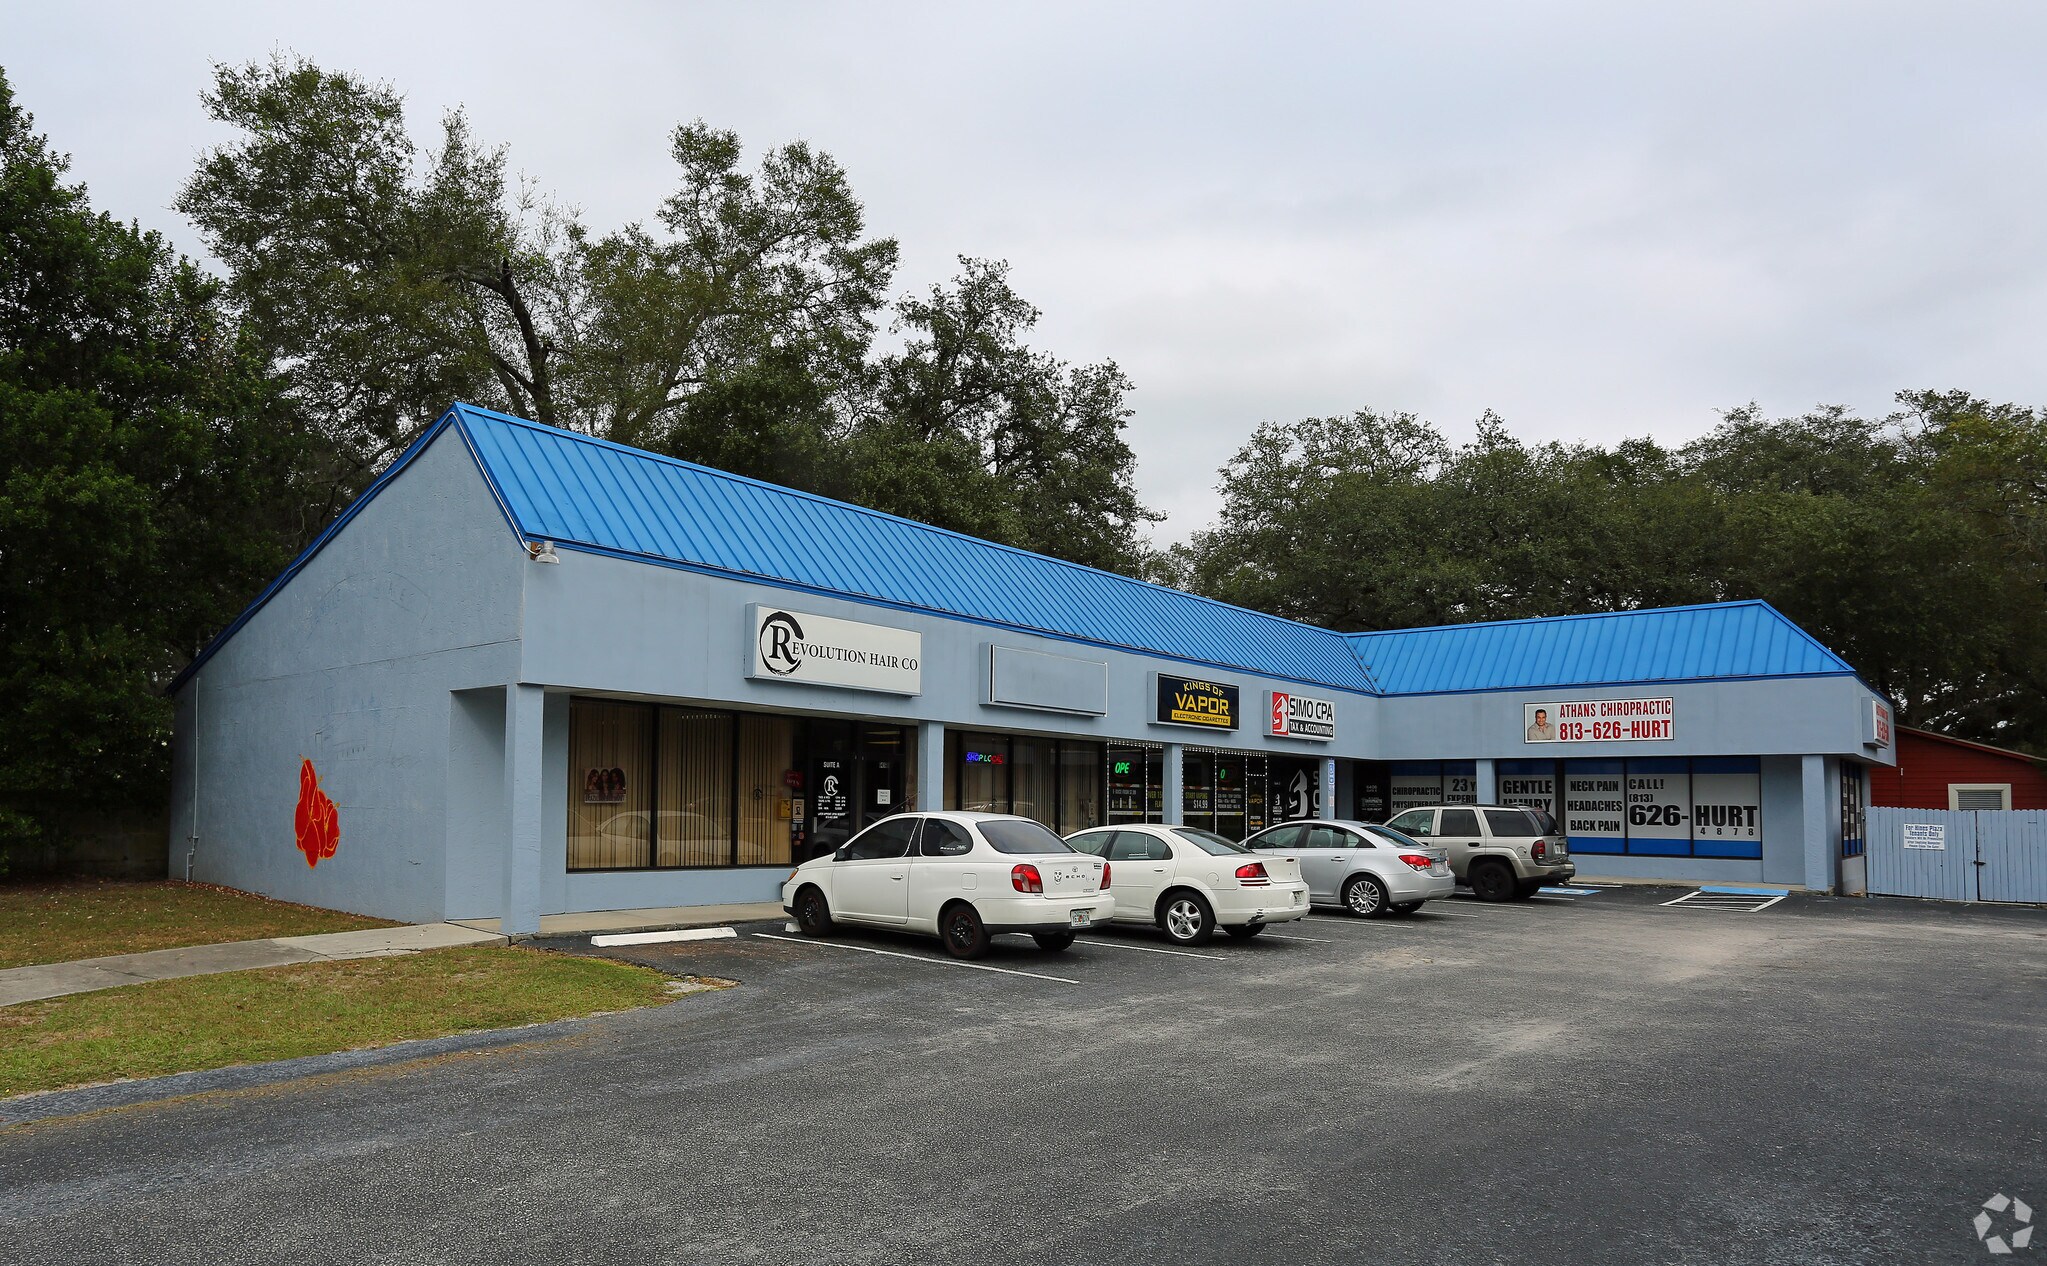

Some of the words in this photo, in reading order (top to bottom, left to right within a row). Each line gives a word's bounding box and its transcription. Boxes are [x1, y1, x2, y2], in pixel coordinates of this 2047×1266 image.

[769, 624, 866, 665] REVOLUTION
[870, 653, 899, 669] HAIR
[901, 657, 918, 671] CO
[1183, 682, 1211, 692] KINGS
[1212, 686, 1224, 697] OF
[1175, 692, 1229, 715] VAPOR
[1289, 697, 1314, 718] SIMO
[1315, 702, 1333, 721] CPA
[1559, 703, 1596, 718] ATHANS
[1601, 700, 1671, 716] CHIROPRACTIC
[1173, 712, 1202, 721] ELECTRONIC
[1202, 715, 1229, 724] CIGARETTES
[1290, 721, 1300, 732] TAX
[1300, 723, 1304, 732] &
[1305, 724, 1333, 736] ACCOUNTING
[1559, 720, 1670, 740] 813-626-HURT
[966, 752, 983, 762] SHOP
[1452, 778, 1468, 792] 23
[1502, 780, 1553, 794] GENTLE
[1570, 780, 1595, 792] NECK
[1597, 780, 1619, 792] PAIN
[1628, 778, 1665, 790] CALL!
[1392, 787, 1441, 796] CHIROPRACTIC
[1628, 794, 1654, 803] (813)
[1193, 799, 1208, 809] $14.99
[1567, 800, 1623, 812] HEADACHES
[1695, 805, 1758, 828] HURT
[1570, 819, 1596, 832] BACK
[1598, 820, 1620, 832] PAIN
